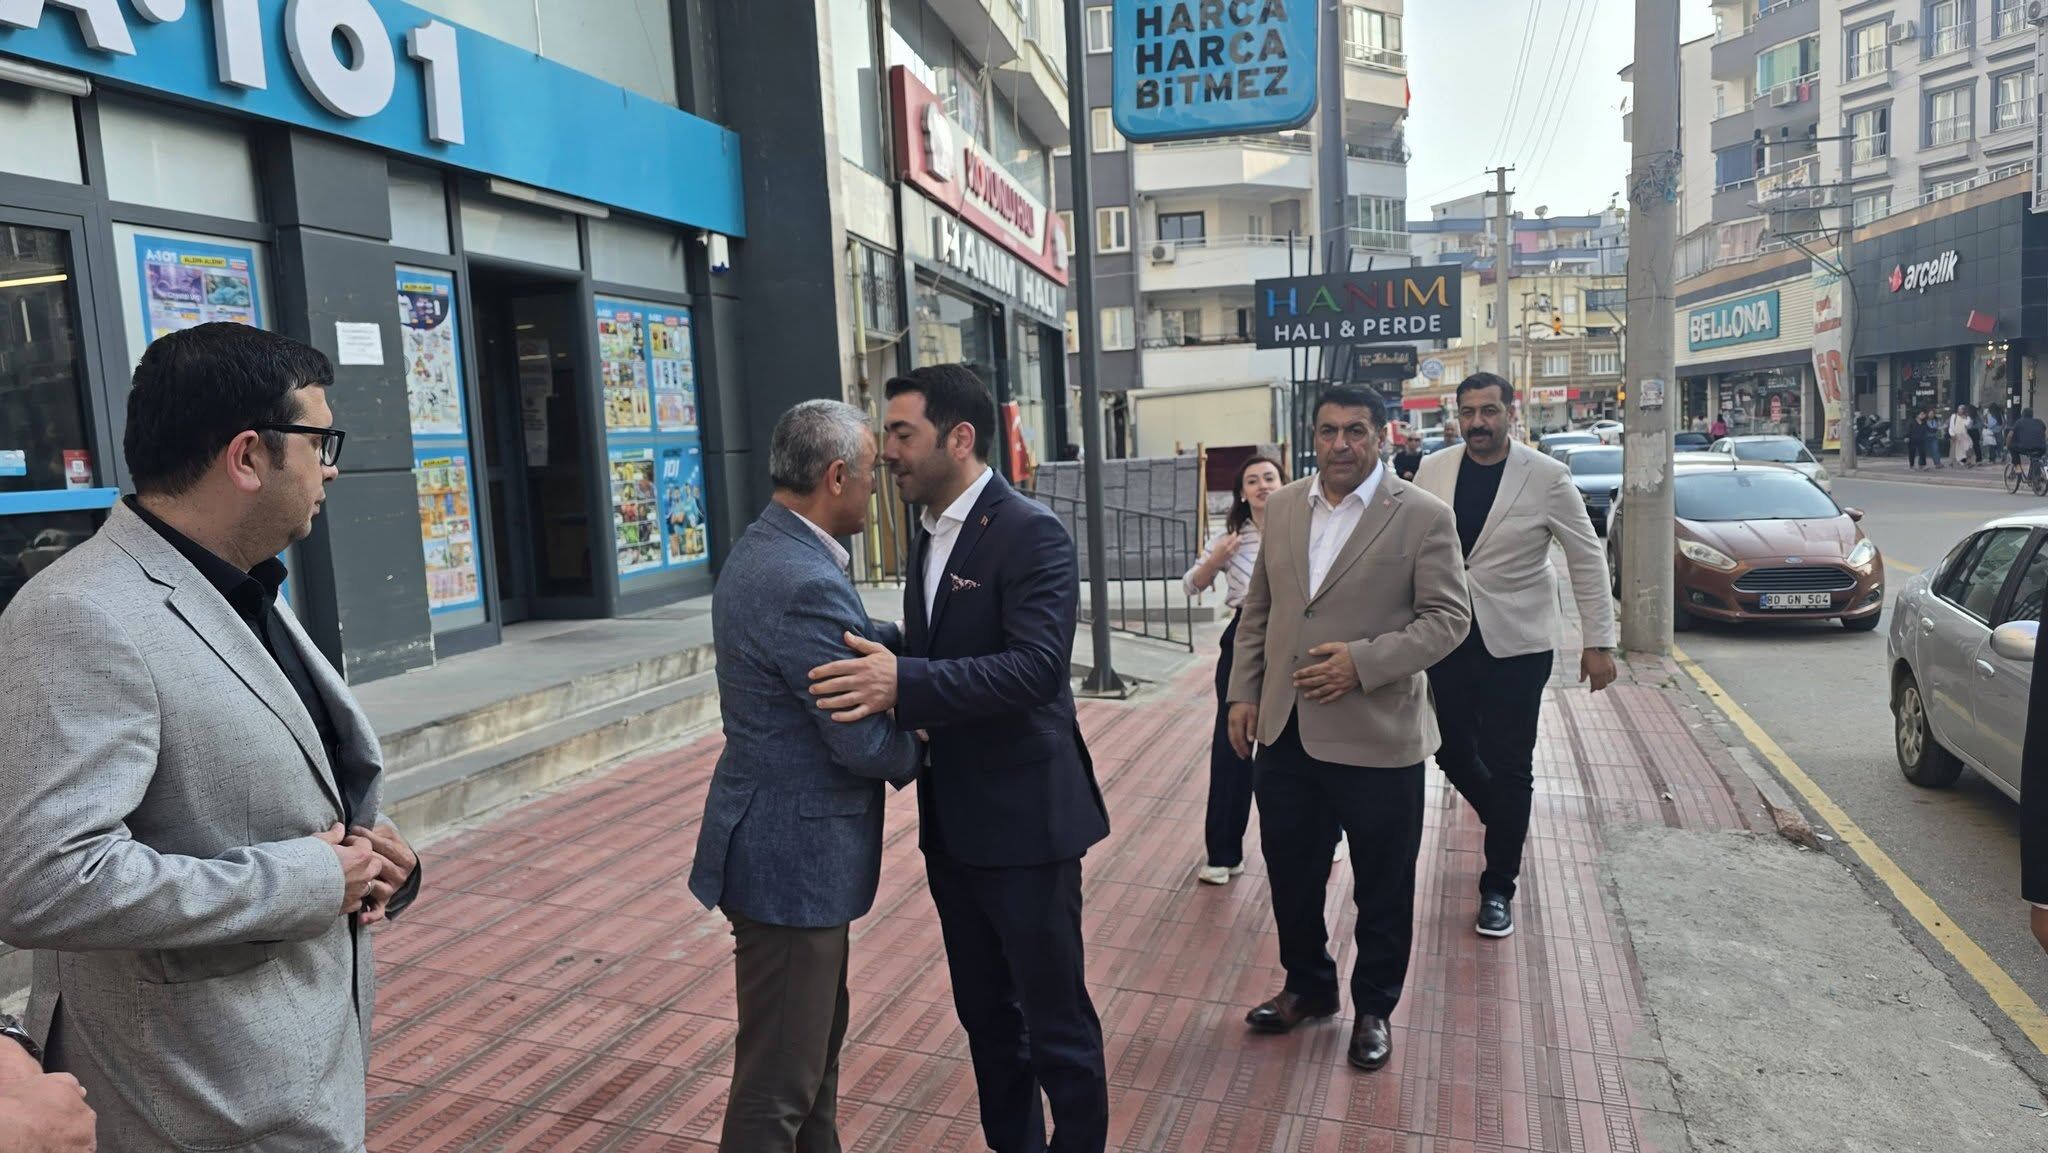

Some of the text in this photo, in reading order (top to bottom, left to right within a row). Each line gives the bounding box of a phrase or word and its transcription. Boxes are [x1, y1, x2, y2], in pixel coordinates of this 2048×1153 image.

[1136, 0, 1288, 39] HARCA
[1136, 29, 1288, 75] HARCA
[937, 215, 1058, 319] HANIM HALI
[1904, 250, 1959, 294] arçelik
[1265, 275, 1449, 319] HANIM
[1274, 314, 1442, 342] HALI & PERDE
[1690, 300, 1773, 343] BELLONA
[1767, 594, 1829, 605] 80 GN 504
